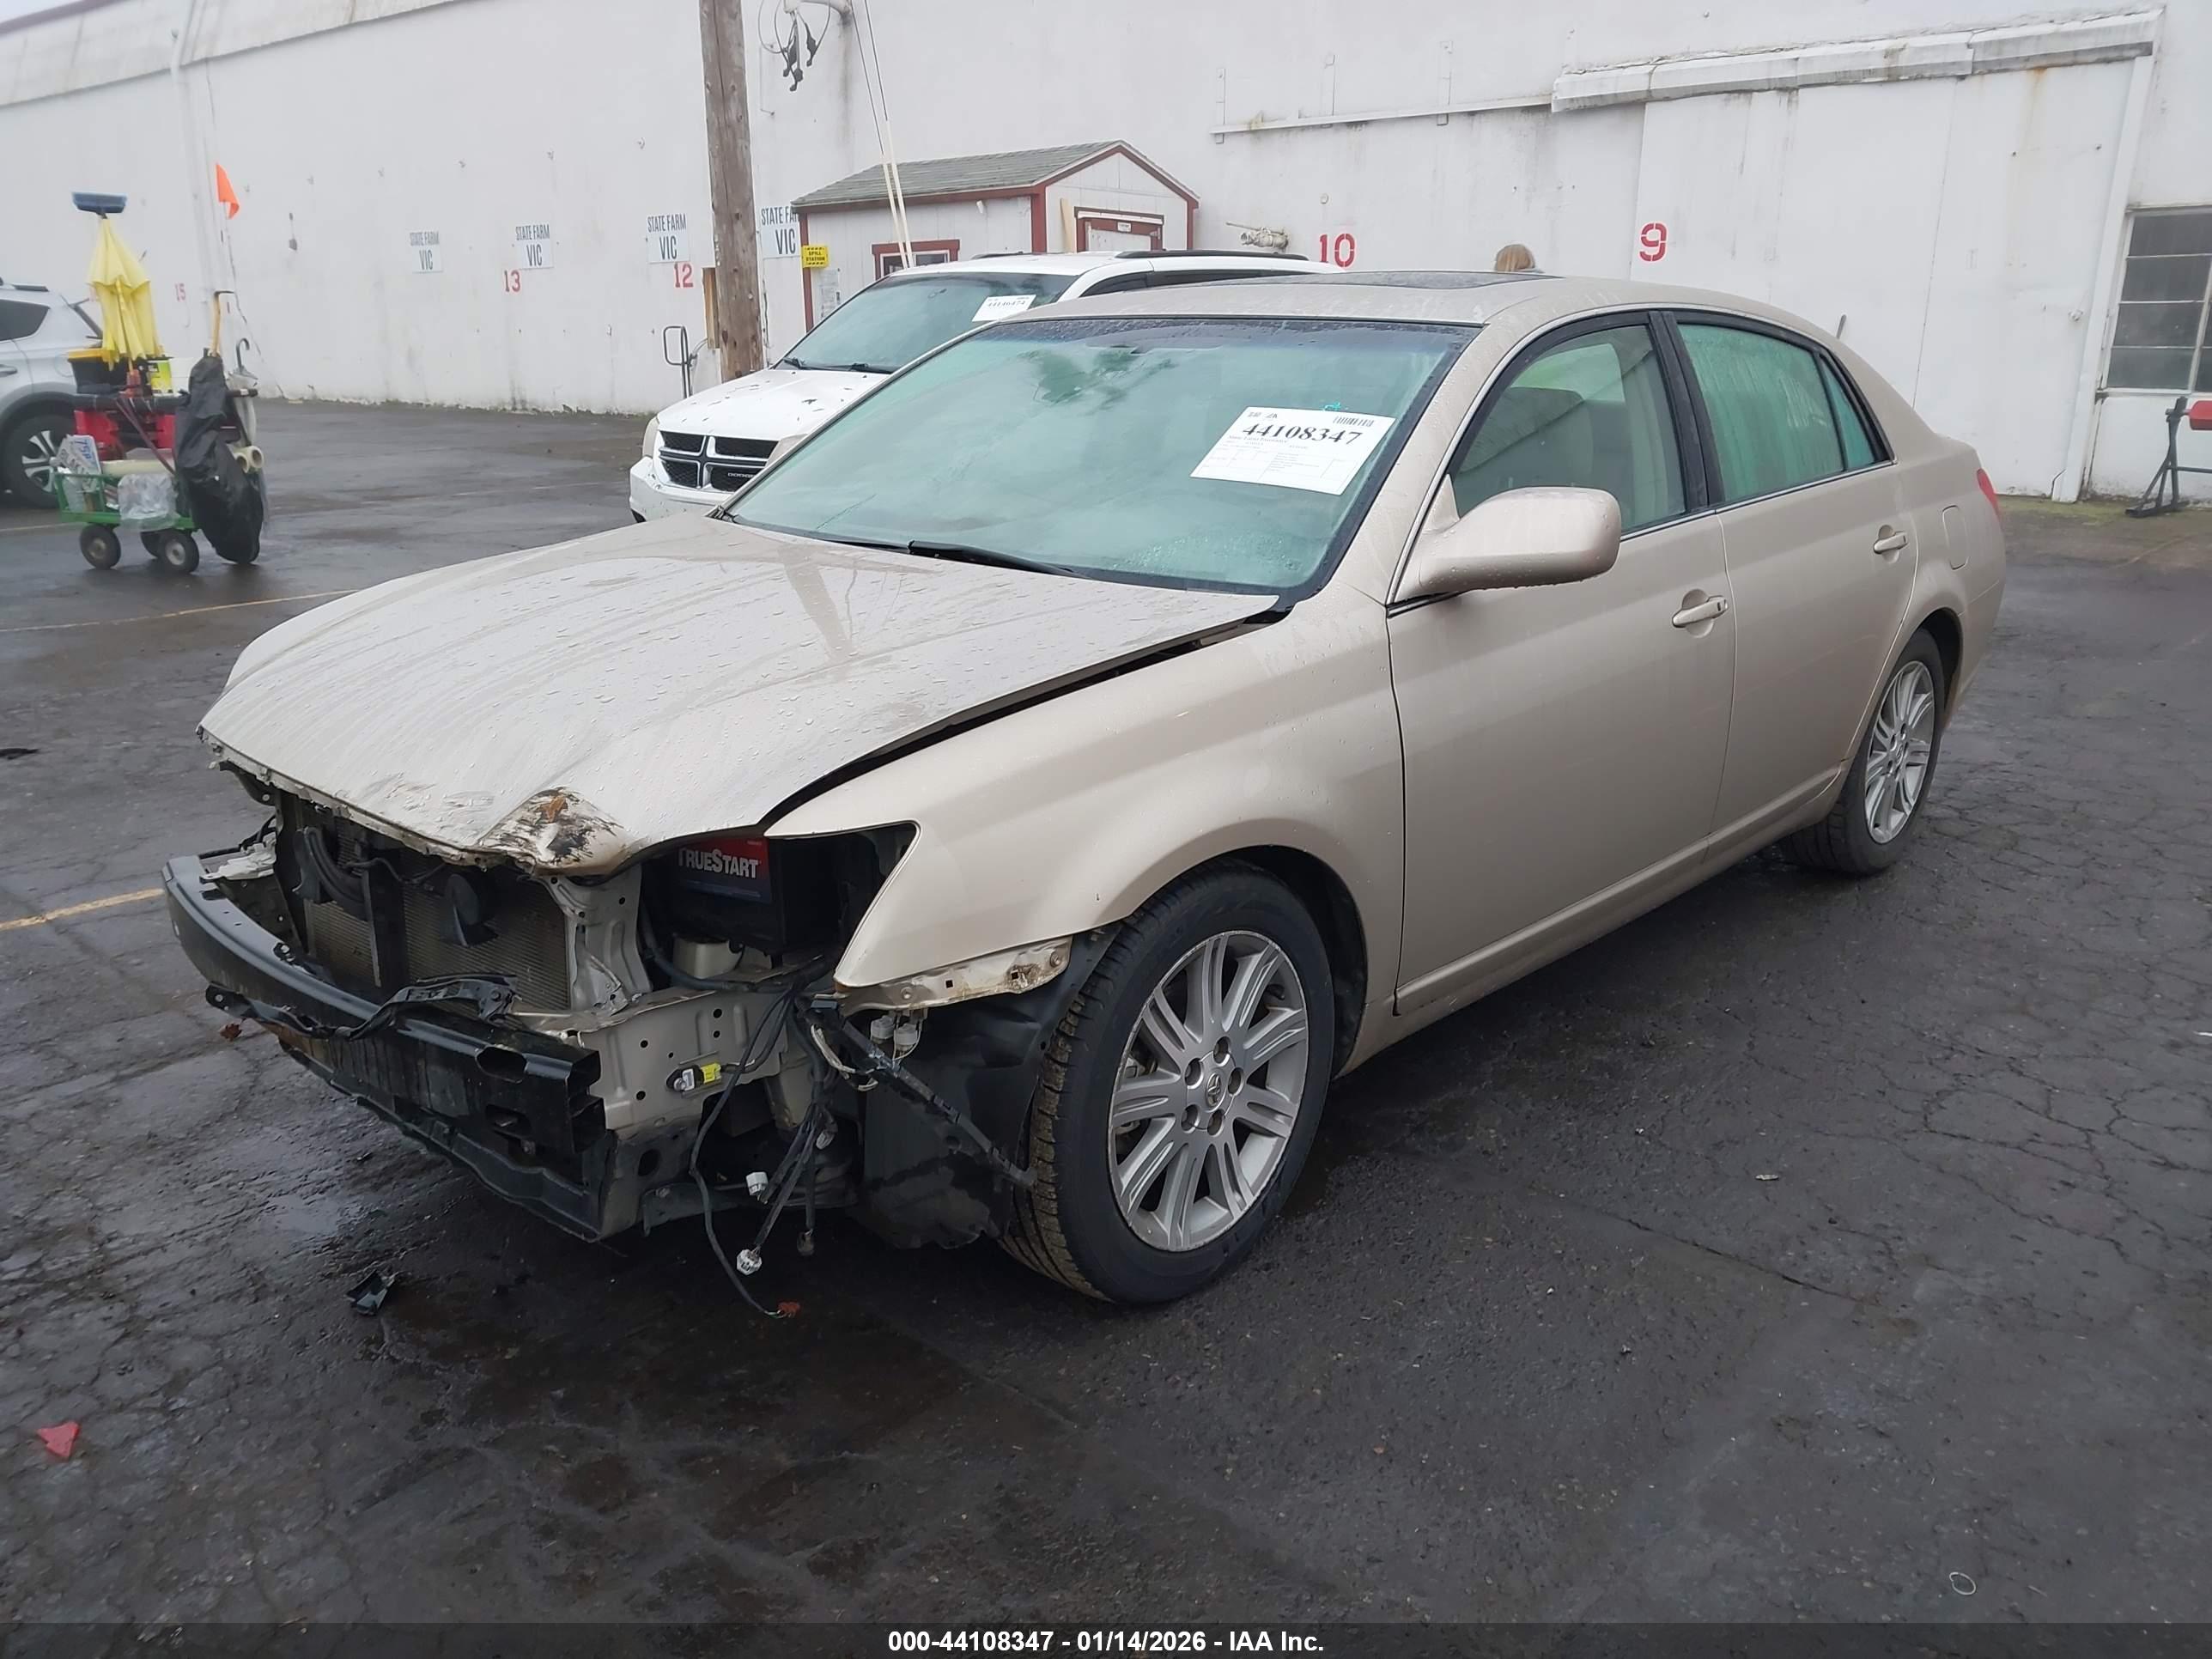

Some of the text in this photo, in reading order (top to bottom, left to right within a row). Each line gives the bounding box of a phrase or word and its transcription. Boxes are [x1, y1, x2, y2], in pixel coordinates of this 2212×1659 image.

[647, 214, 687, 233] STATE FARM
[762, 205, 797, 225] STATE FA
[515, 223, 550, 241] STATE FARM
[775, 228, 796, 254] VIC
[1639, 222, 1668, 262] 9
[526, 244, 543, 266] VIC
[659, 235, 678, 260] VIC
[1319, 233, 1356, 268] 10
[419, 250, 434, 270] VIC
[504, 270, 521, 292] 13
[674, 262, 694, 288] 12
[1243, 423, 1364, 445] 44108347
